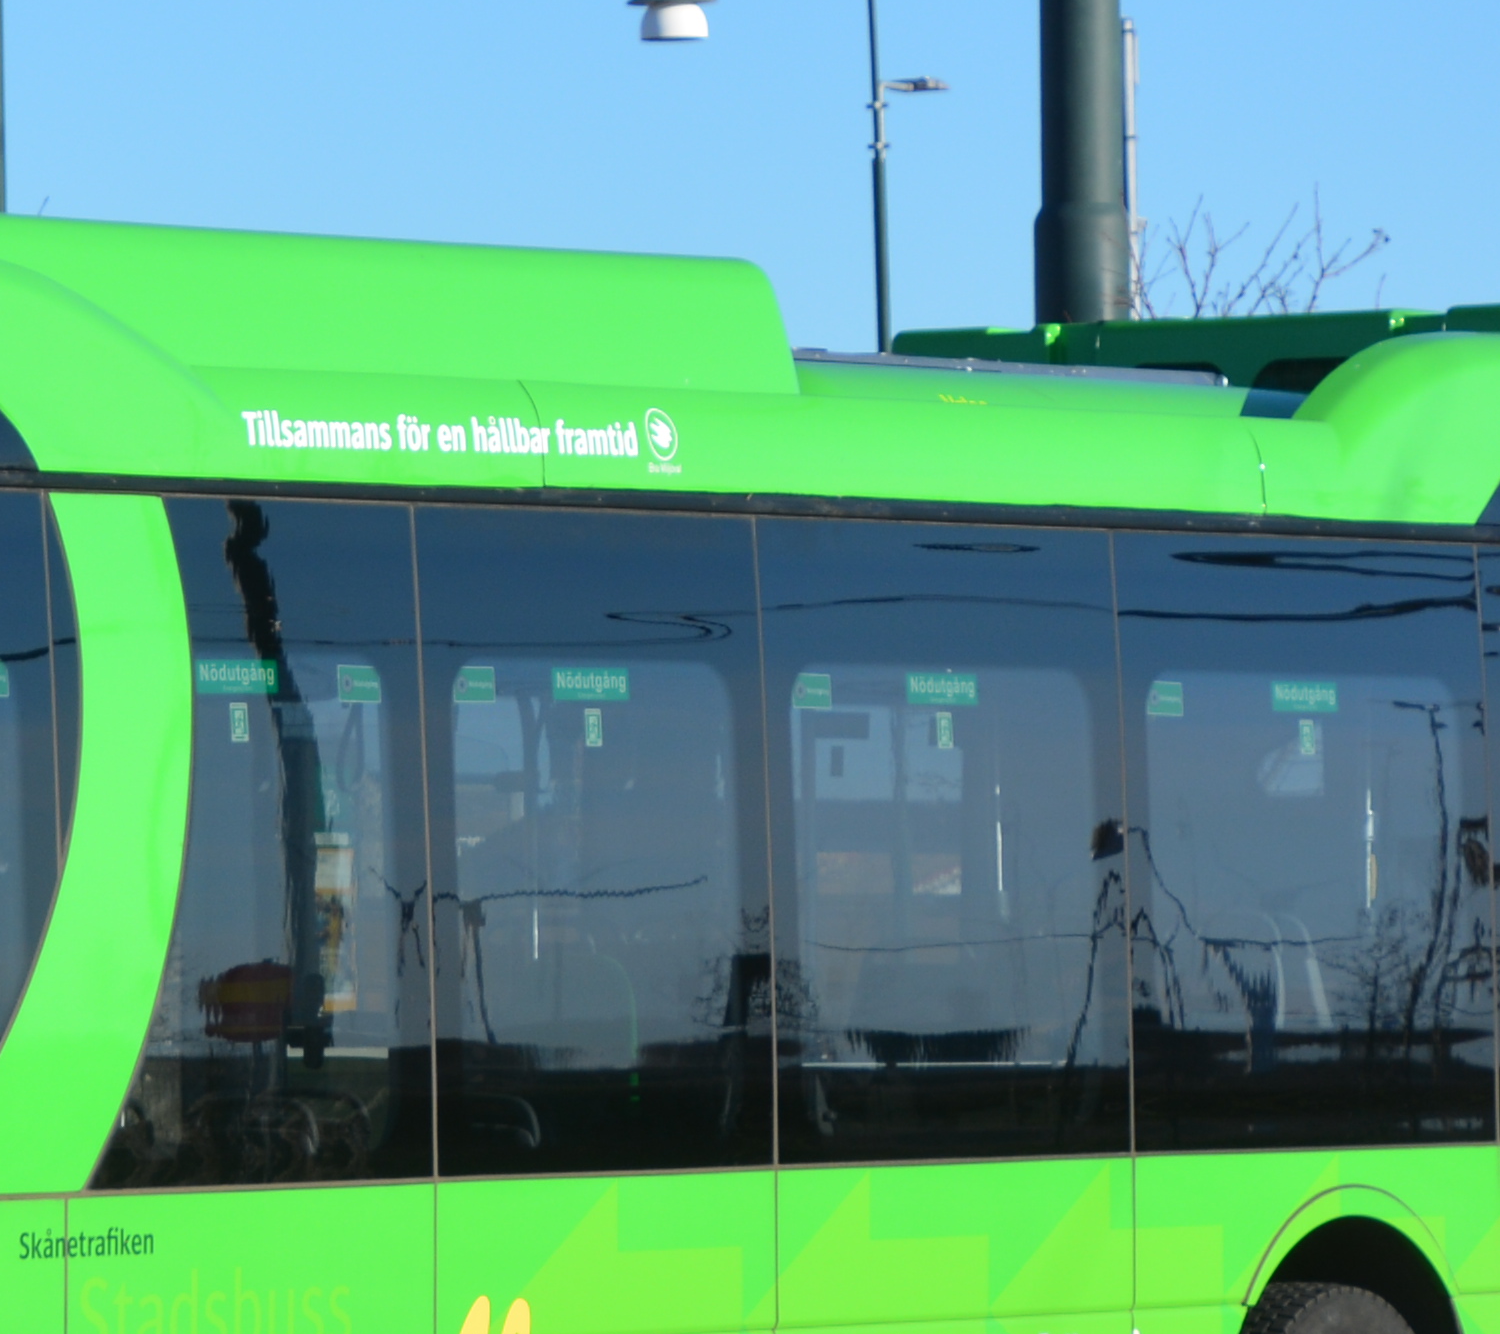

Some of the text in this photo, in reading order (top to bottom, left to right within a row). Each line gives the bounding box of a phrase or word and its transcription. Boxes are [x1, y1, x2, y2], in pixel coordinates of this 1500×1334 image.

[241, 410, 639, 457] Tillsammans för en hållbar framtid
[199, 662, 275, 686] Nödutgång
[556, 670, 627, 694] Nödutgång
[910, 676, 976, 698] Nödutgång
[1274, 684, 1337, 706] Nödutgång
[18, 1227, 155, 1261] Skånetrafiken
